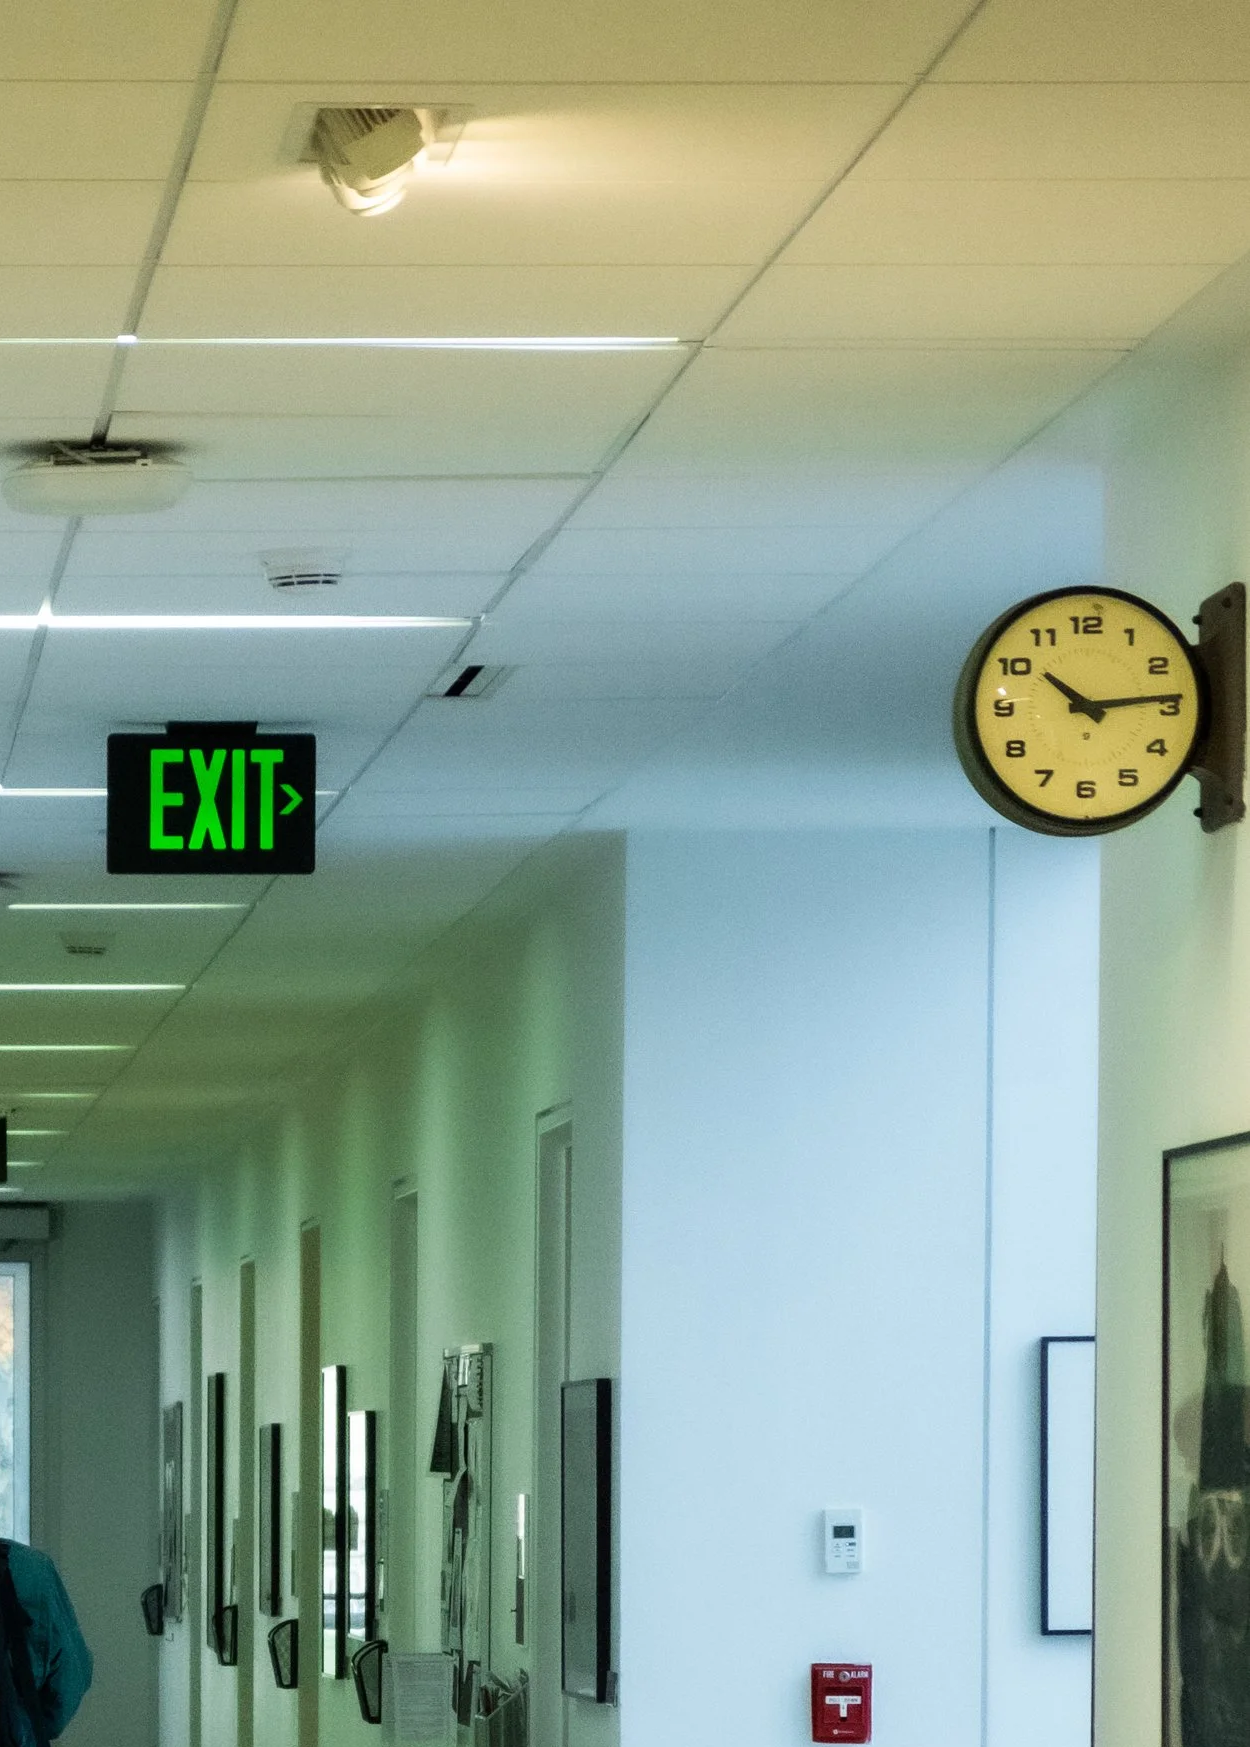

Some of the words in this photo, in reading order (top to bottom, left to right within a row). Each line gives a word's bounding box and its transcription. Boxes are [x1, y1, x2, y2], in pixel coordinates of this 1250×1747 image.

[1069, 616, 1103, 634] 12
[1030, 628, 1057, 646] 11
[1123, 628, 1135, 646] 1
[997, 657, 1032, 675] 10
[1148, 657, 1169, 675] 2
[993, 699, 1015, 717] 9
[1159, 698, 1180, 716] 3
[1005, 740, 1026, 758] 8
[1146, 738, 1168, 756] 4
[1034, 769, 1054, 787] 7
[1118, 769, 1139, 787] 5
[1076, 780, 1096, 799] 6
[150, 749, 284, 850] EXIT
